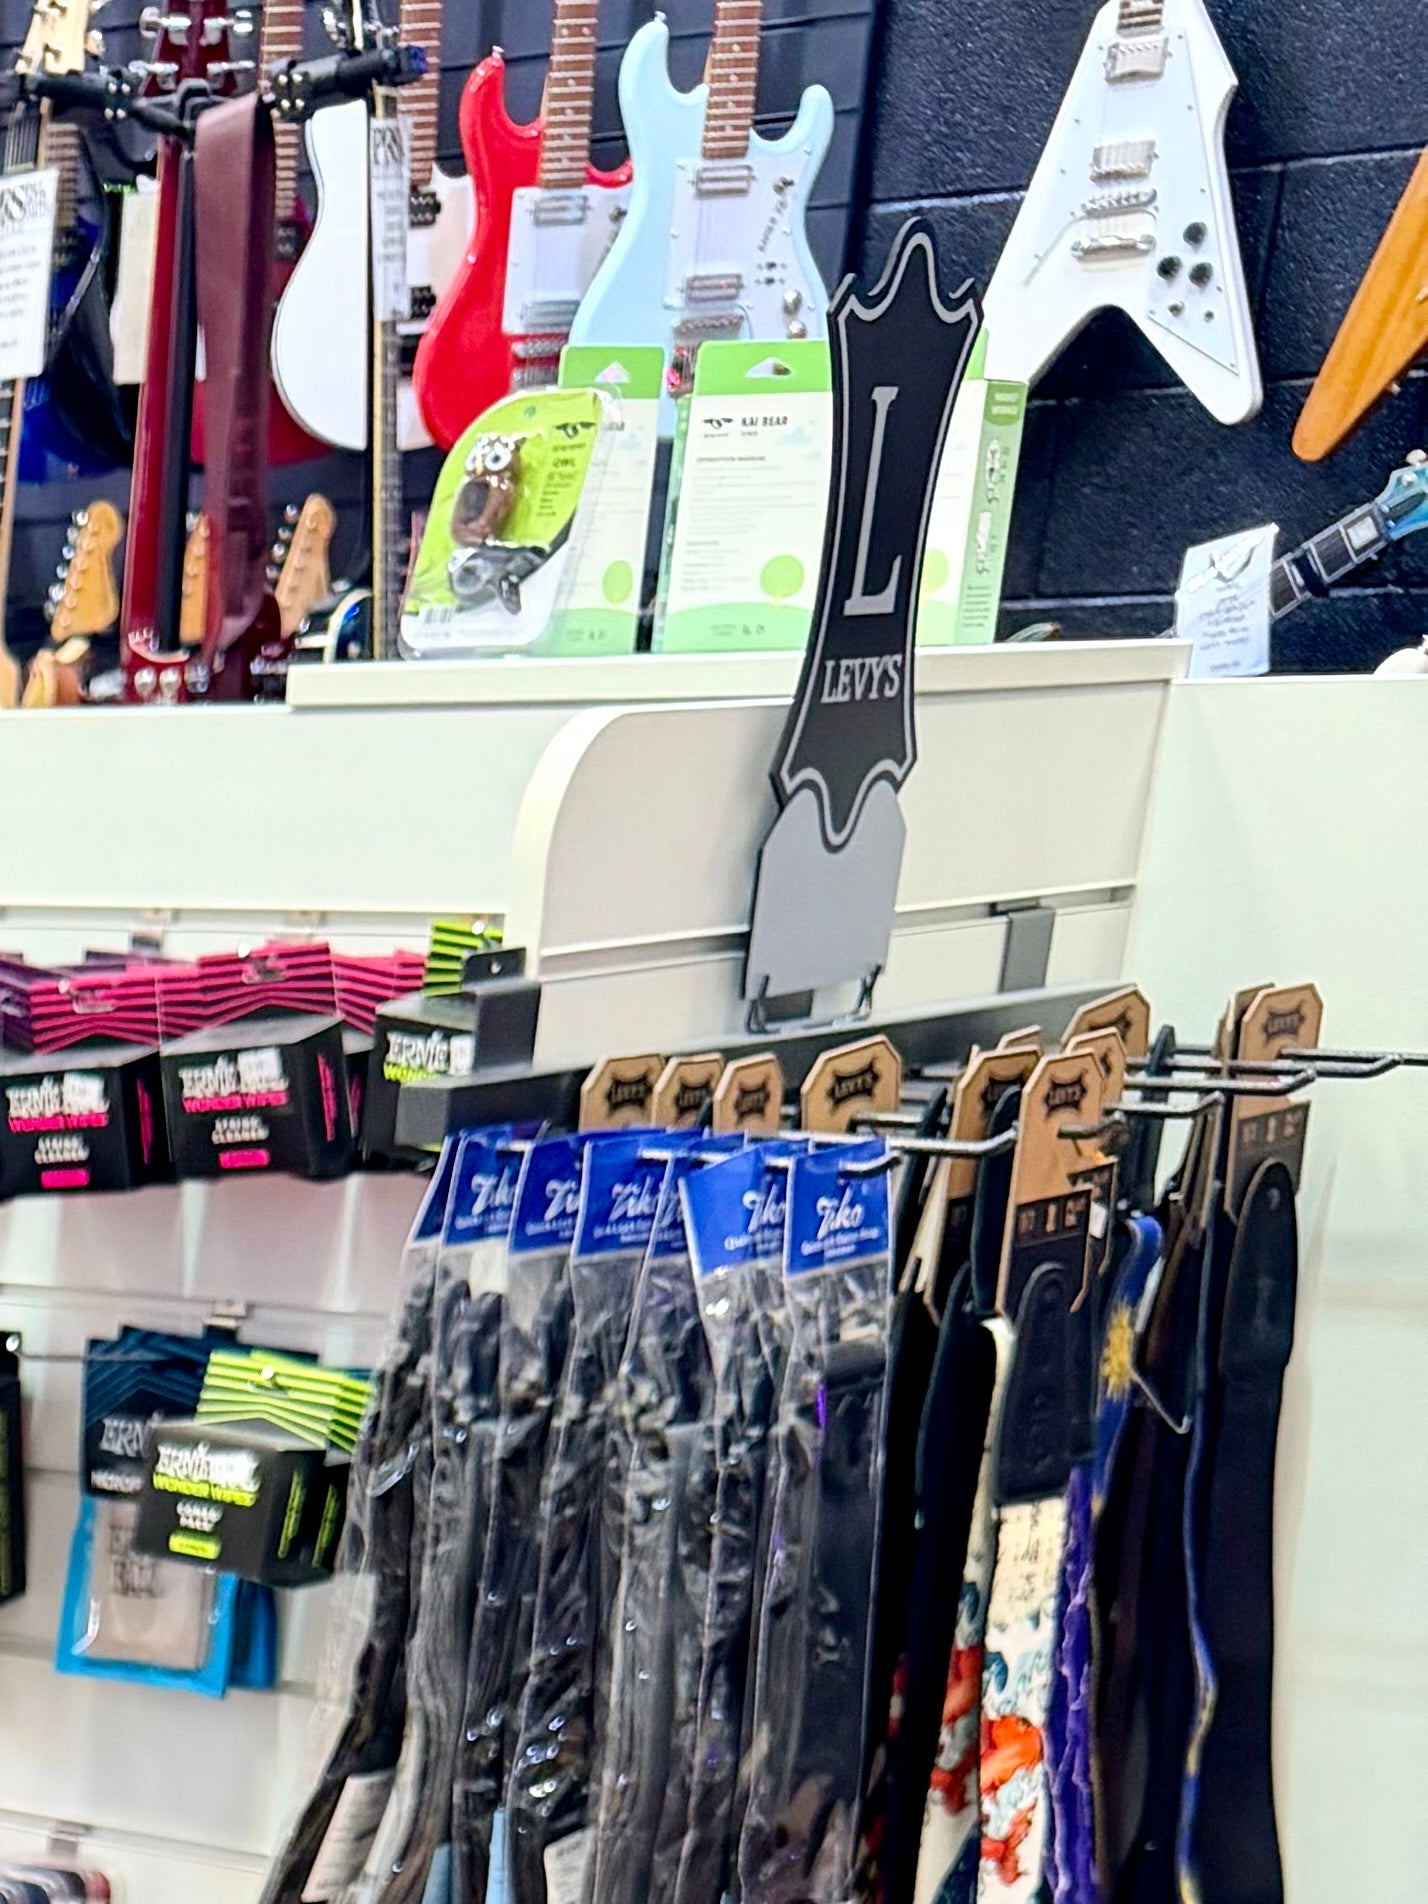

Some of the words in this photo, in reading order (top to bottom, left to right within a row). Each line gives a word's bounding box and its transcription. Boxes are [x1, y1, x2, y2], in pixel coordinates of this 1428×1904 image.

[820, 653, 903, 704] LEVY'S
[385, 1029, 450, 1075] ERNIE
[5, 1074, 60, 1119] ERNIE
[177, 1054, 240, 1099] ERNIE
[153, 1472, 211, 1498] WONDER
[211, 1482, 258, 1508] WIPES
